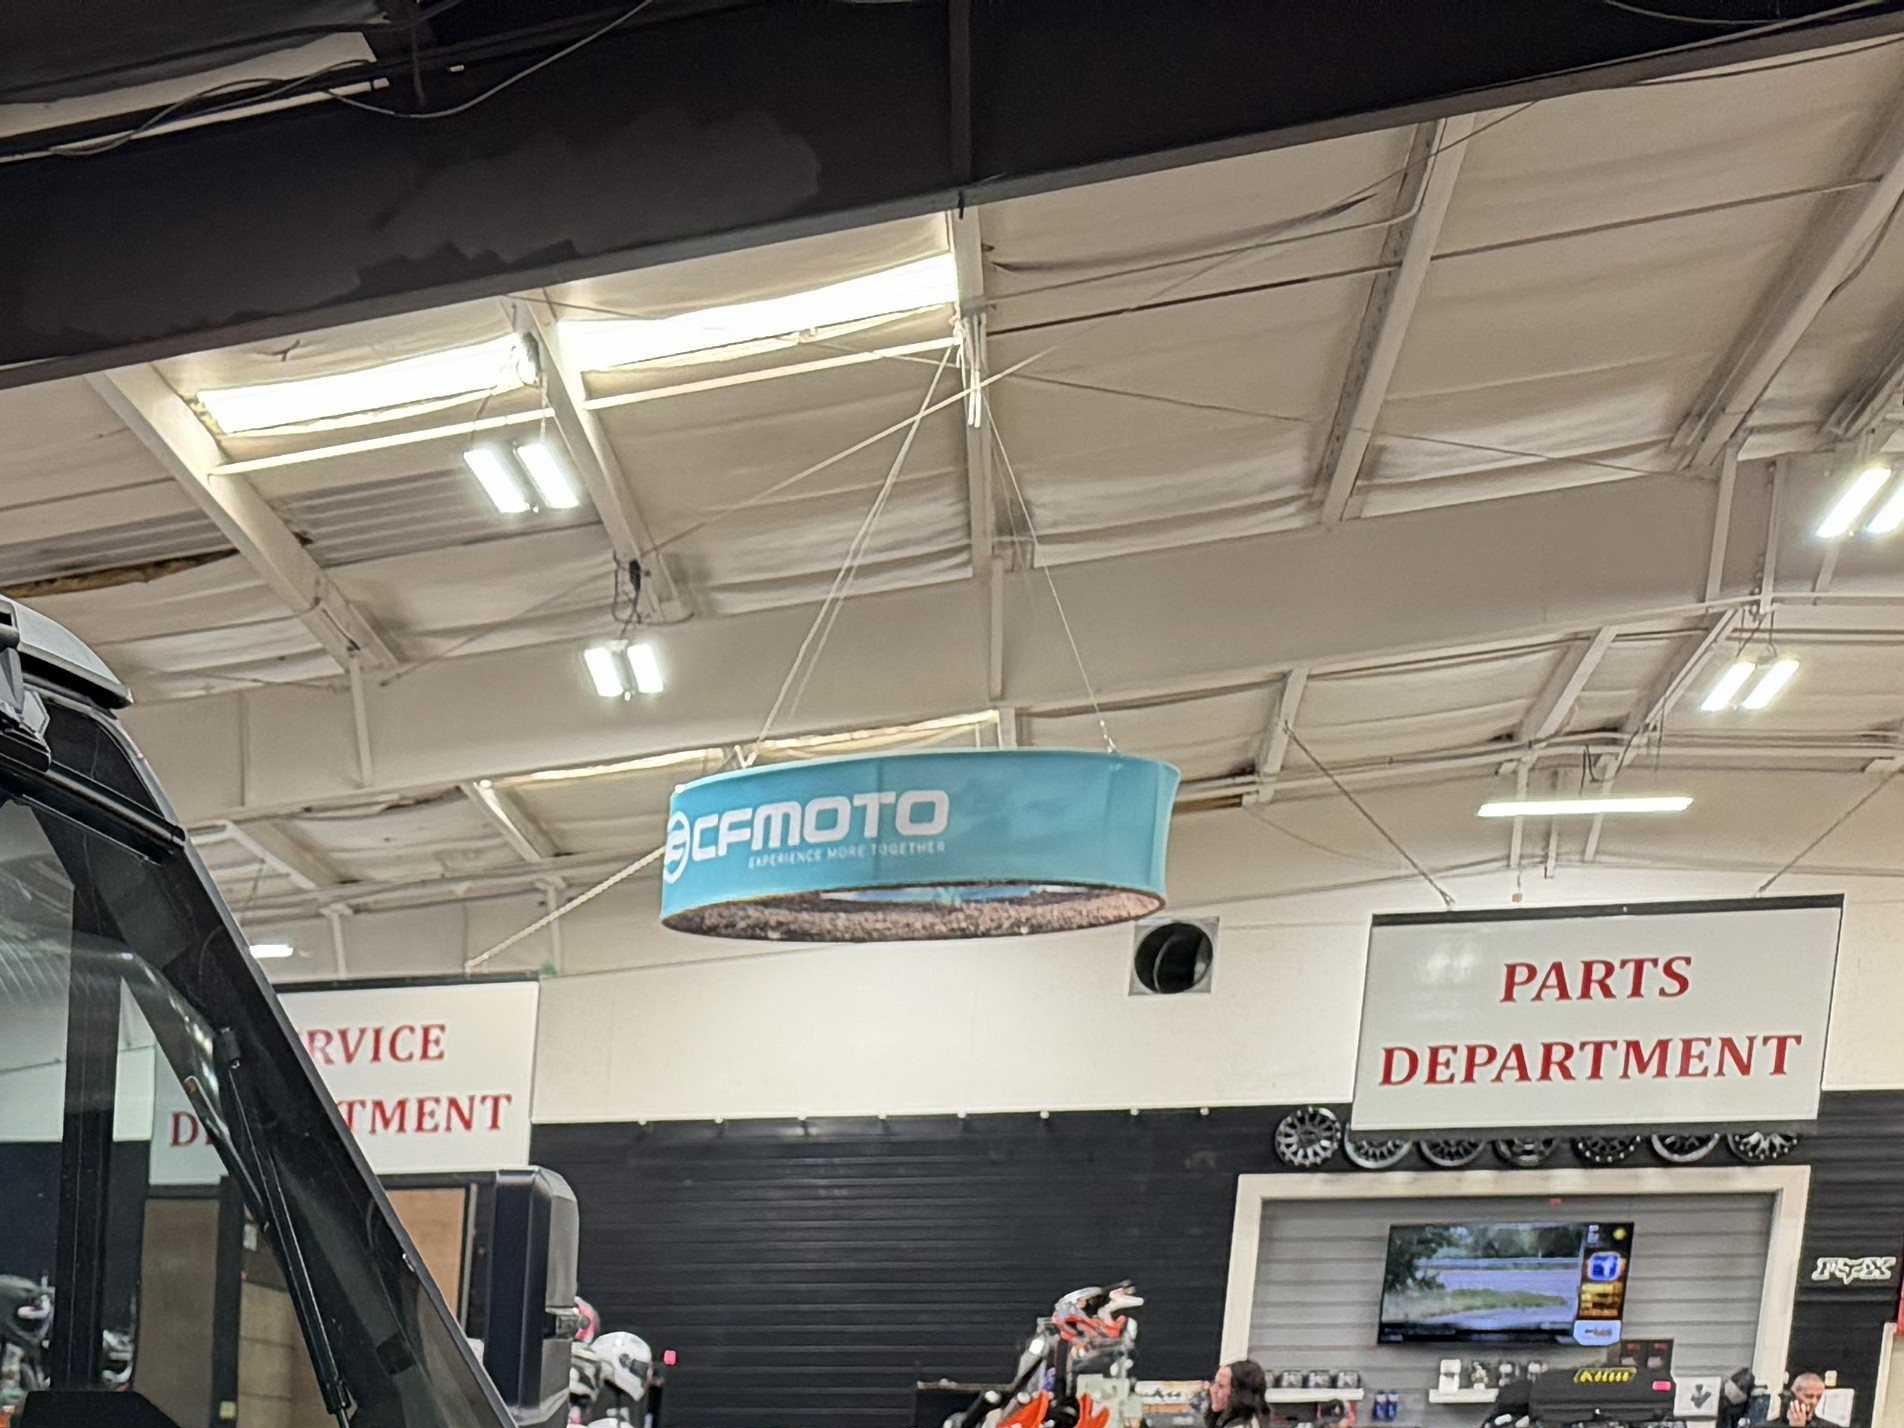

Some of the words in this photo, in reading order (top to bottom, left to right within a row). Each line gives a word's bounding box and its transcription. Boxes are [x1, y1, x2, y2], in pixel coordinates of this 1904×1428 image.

[692, 790, 959, 862] CFMOTO
[826, 846, 865, 860] MORE
[1500, 955, 1692, 1004] PARTS
[298, 1023, 447, 1067] RVICE
[1378, 1034, 1803, 1088] DEPARTMENT
